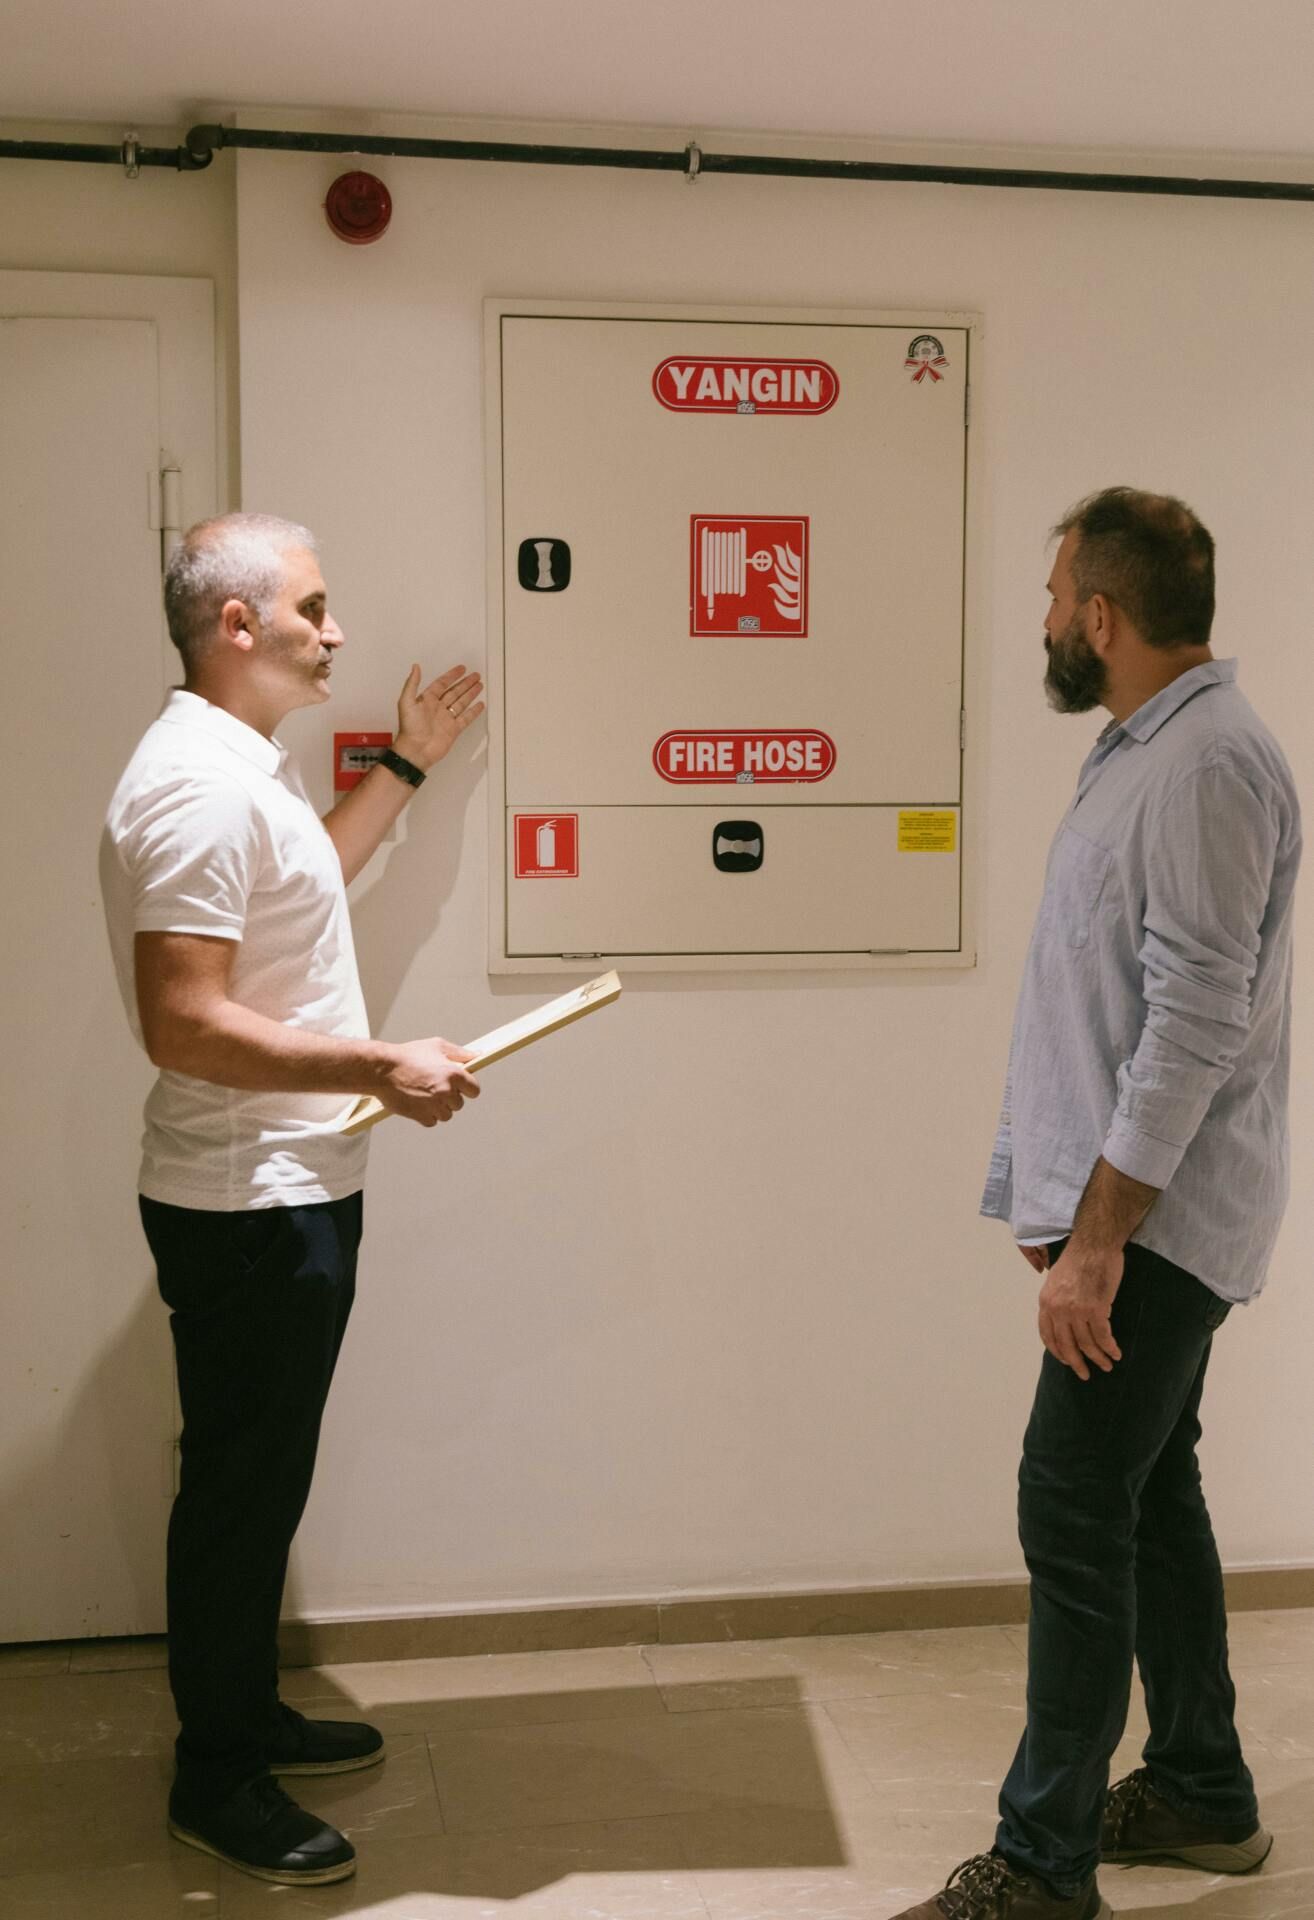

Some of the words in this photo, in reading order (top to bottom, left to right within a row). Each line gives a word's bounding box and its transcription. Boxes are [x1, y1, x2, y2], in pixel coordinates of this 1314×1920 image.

[667, 366, 820, 403] YANGIN
[669, 741, 734, 772] FIRE
[743, 740, 822, 772] HOSE
